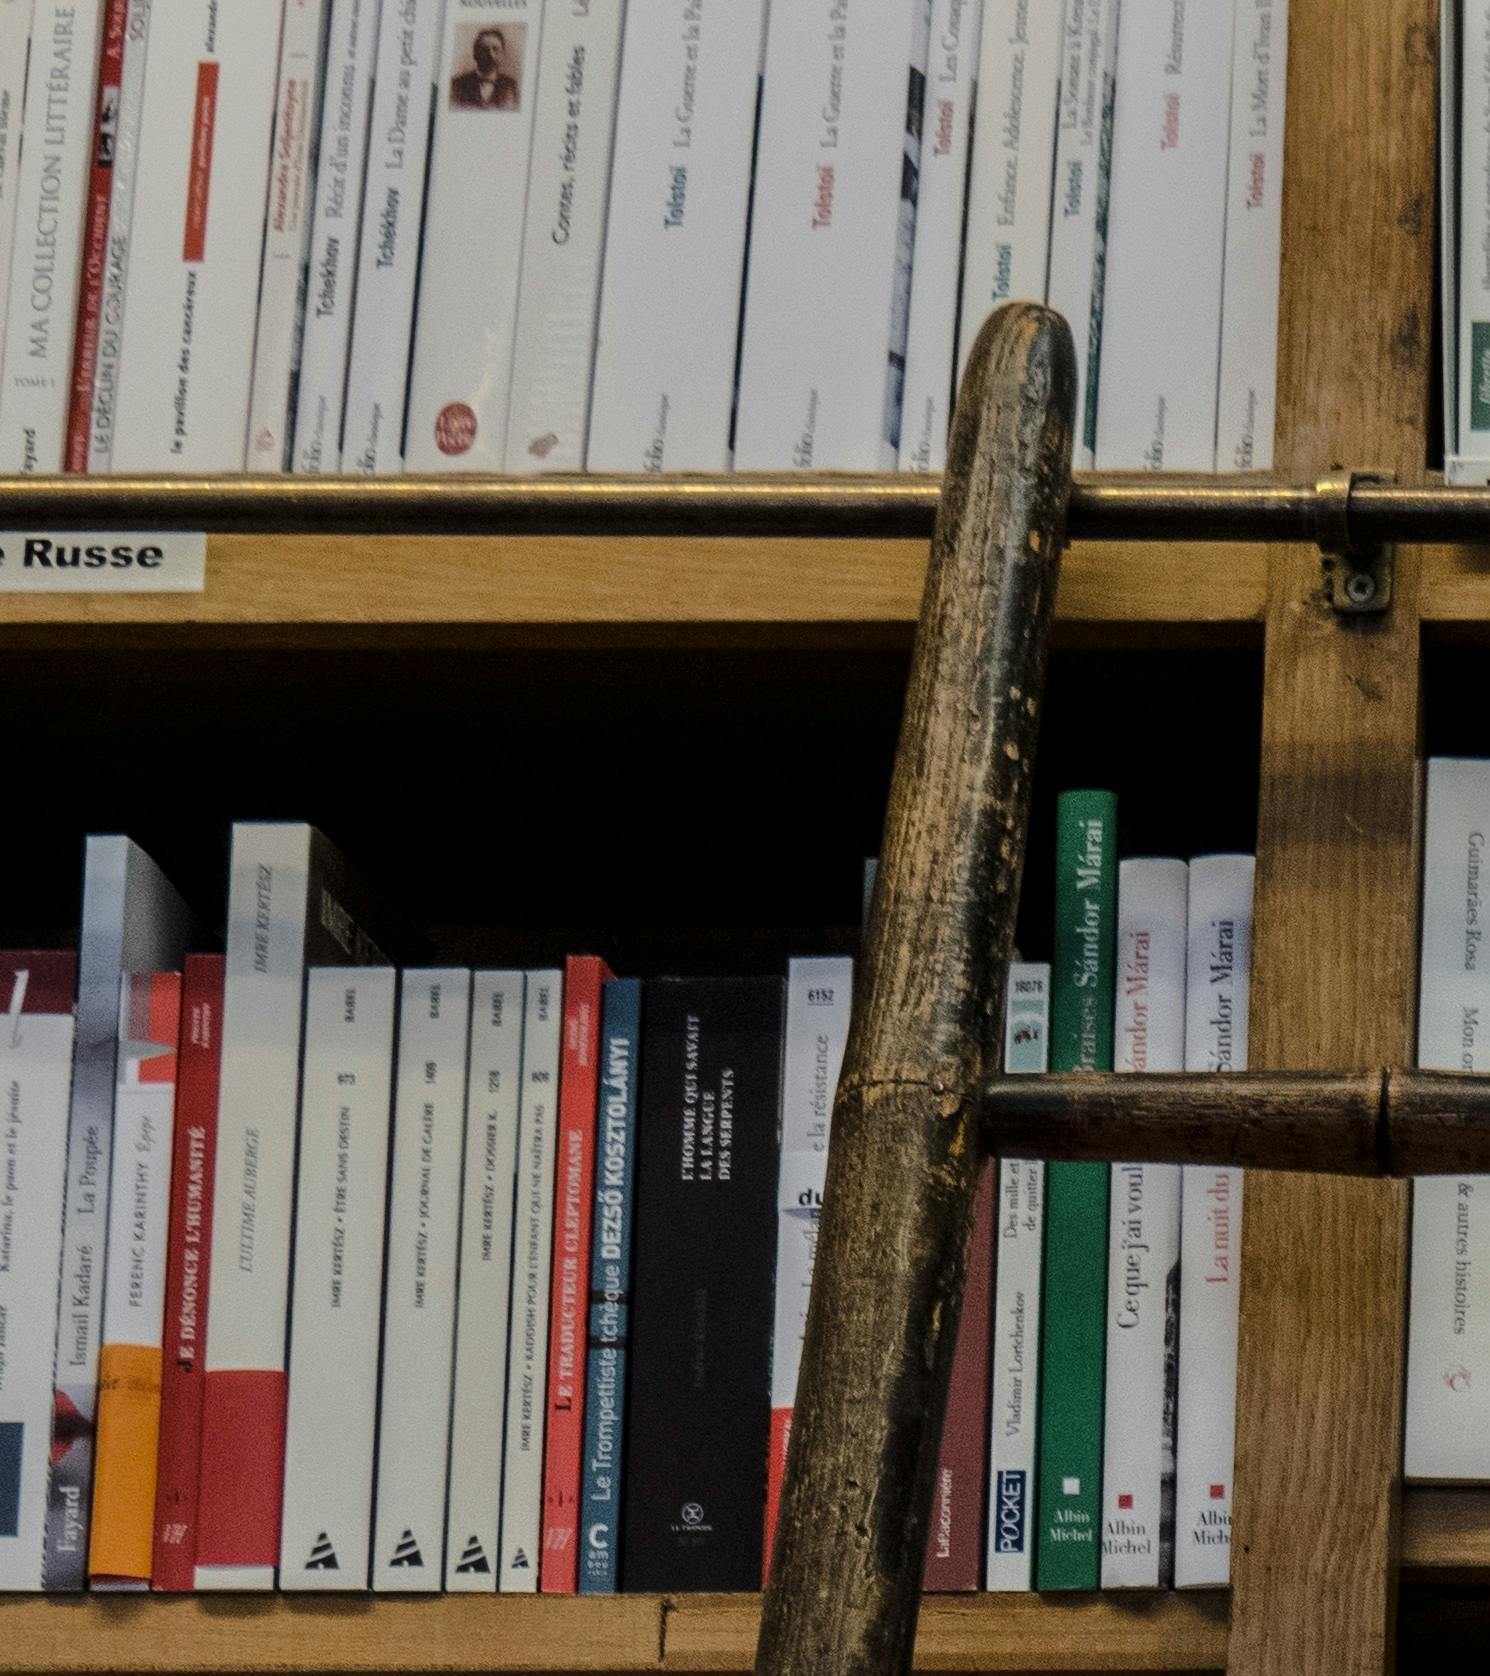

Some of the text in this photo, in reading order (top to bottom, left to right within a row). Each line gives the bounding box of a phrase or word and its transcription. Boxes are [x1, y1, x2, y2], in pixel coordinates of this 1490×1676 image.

[566, 97, 582, 119] et
[26, 2, 75, 360] MA COLLECTION LITTÉRAIRE
[22, 537, 164, 569] Russe
[1072, 818, 1104, 989] Sándor Márai
[602, 1036, 631, 1187] KOSZTOLÁNYI
[67, 1124, 104, 1367] Ismail Kadaré La Poupée
[127, 1160, 149, 1308] FERENC KARINTHY
[595, 1263, 624, 1343] tchèque
[590, 1346, 619, 1473] Trompettiste
[55, 1484, 84, 1553] Fayard
[589, 1474, 613, 1501] Le
